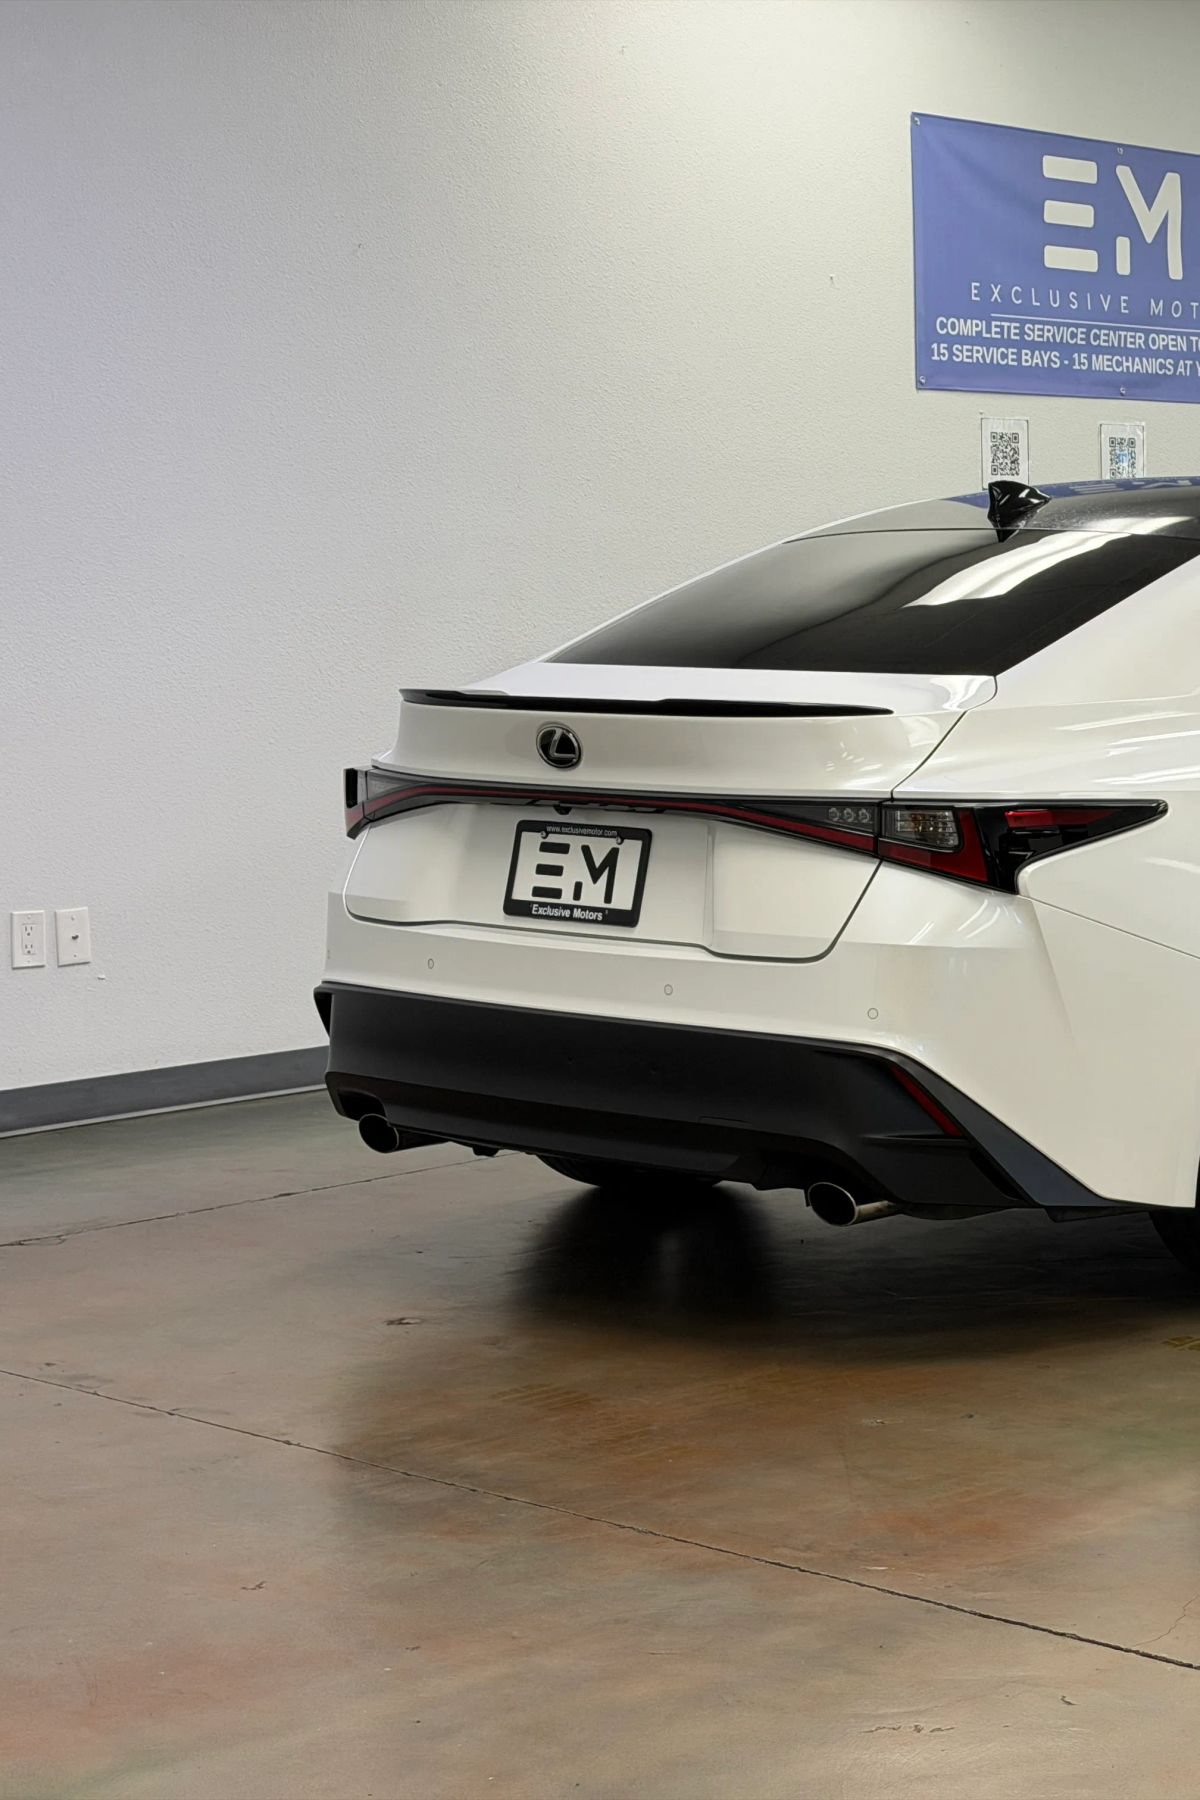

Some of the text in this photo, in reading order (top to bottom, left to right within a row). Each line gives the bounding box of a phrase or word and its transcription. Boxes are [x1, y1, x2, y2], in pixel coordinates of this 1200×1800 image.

[1042, 155, 1183, 280] EM
[971, 282, 1129, 314] EXCLUSIVE
[935, 316, 1020, 340] COMPLETE
[1023, 323, 1087, 345] SERVICE
[1090, 328, 1145, 349] CENTER
[1148, 333, 1188, 352] OPEN
[931, 342, 949, 361] 15
[952, 344, 1018, 366] SERVICE
[1021, 349, 1061, 369] BAYS
[1072, 352, 1089, 370] 15
[1091, 353, 1174, 376] MECHANICS
[1176, 359, 1193, 377] AT
[531, 841, 620, 904] EM
[531, 904, 603, 921] Exclusive Motors
